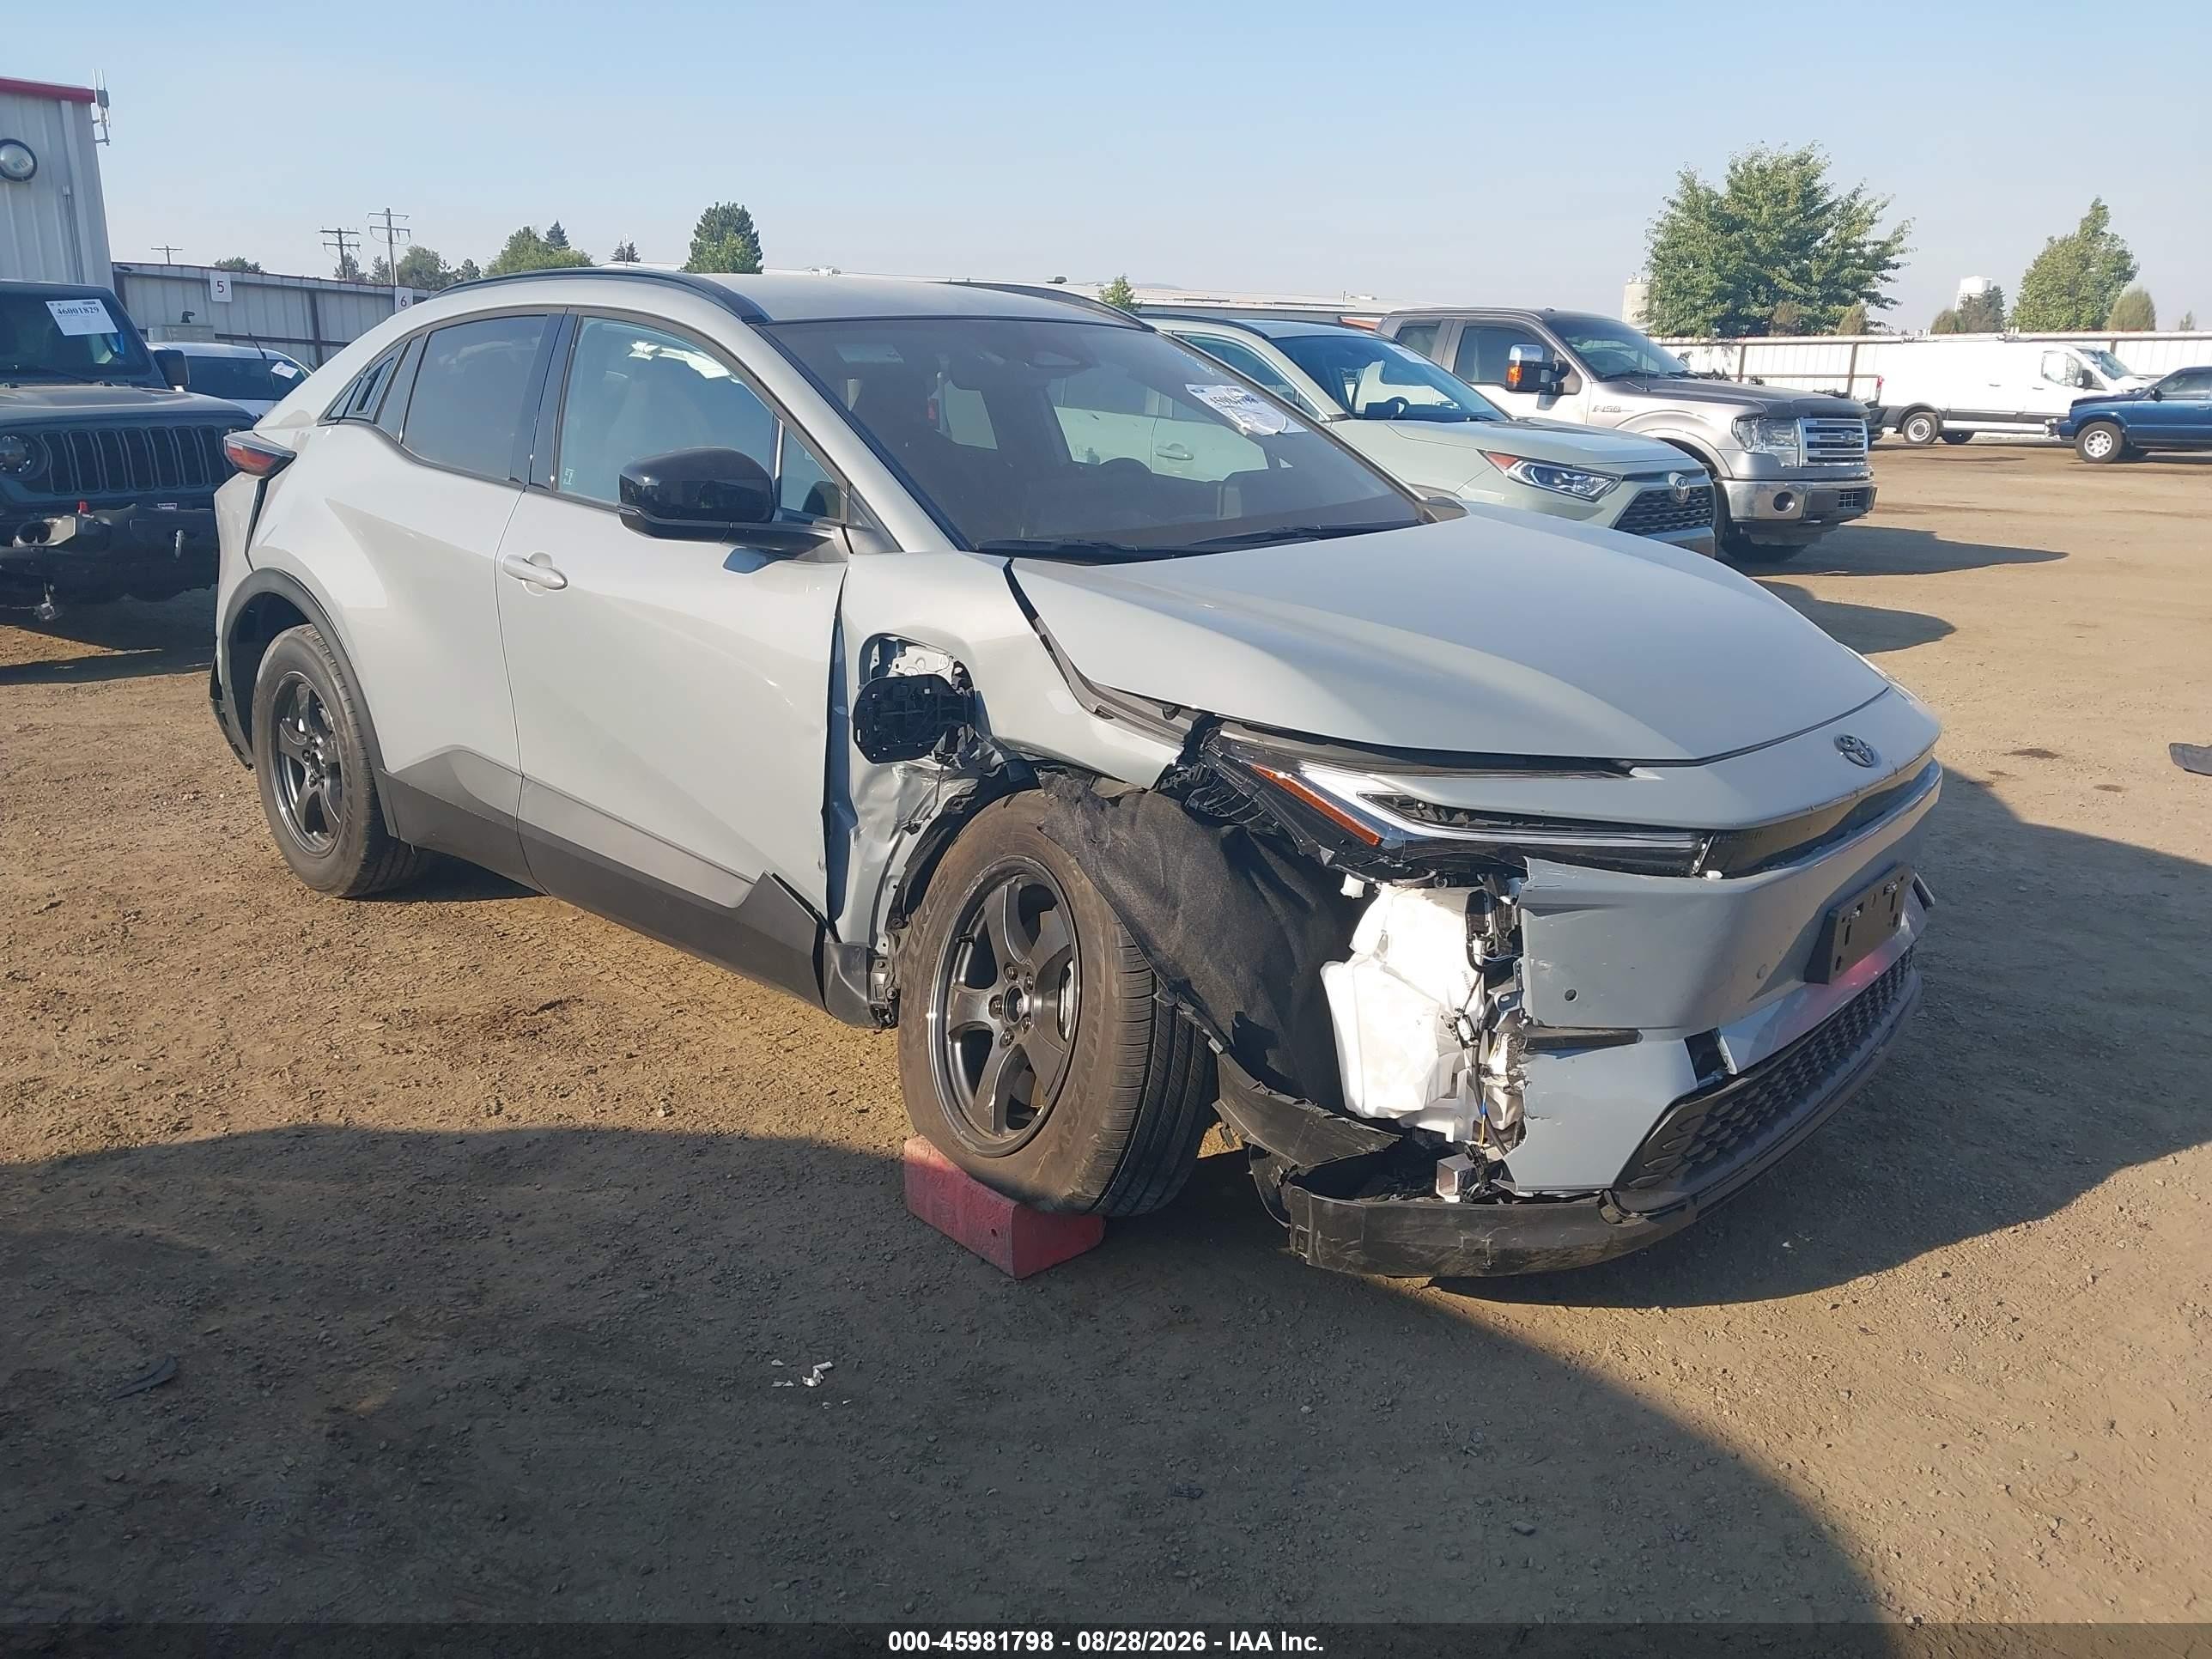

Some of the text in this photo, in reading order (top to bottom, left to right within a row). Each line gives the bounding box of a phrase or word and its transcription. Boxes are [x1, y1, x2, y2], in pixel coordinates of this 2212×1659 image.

[216, 280, 225, 293] 5
[400, 295, 407, 307] 6
[57, 306, 100, 315] 46001829
